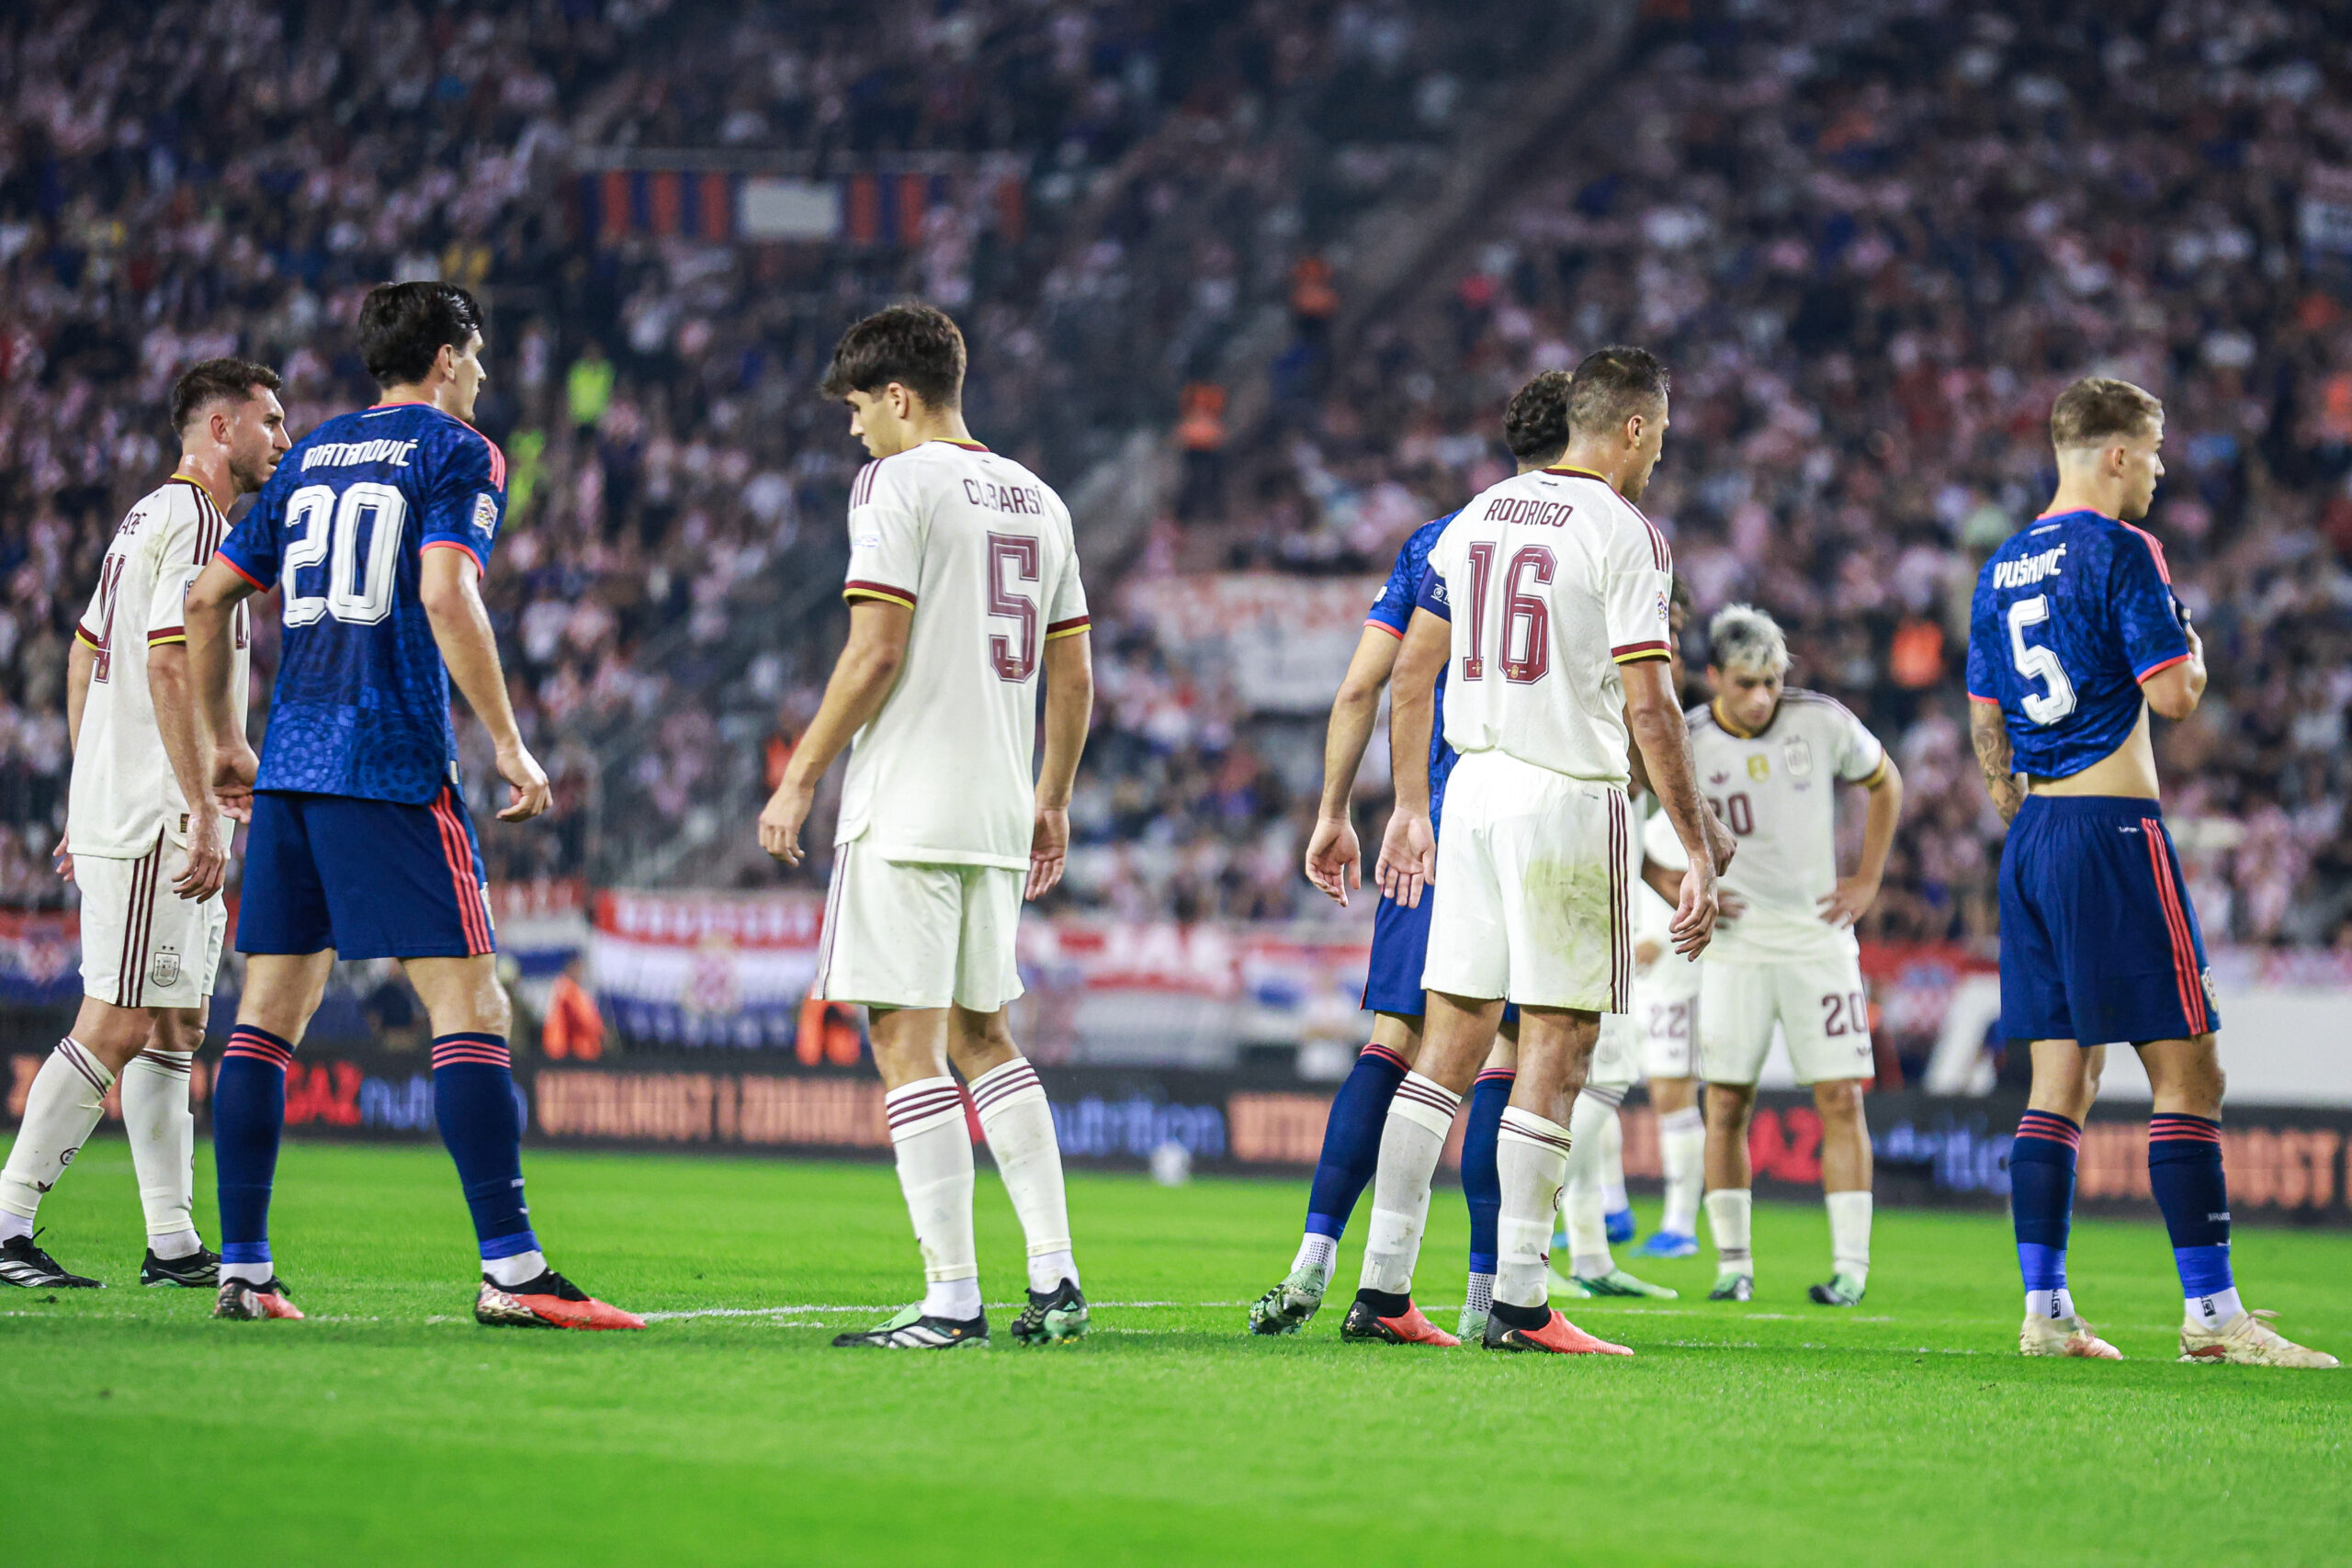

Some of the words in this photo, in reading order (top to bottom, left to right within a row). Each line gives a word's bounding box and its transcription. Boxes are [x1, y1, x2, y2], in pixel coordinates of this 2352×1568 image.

[300, 438, 419, 473] MATANOVIĆ
[281, 481, 408, 628] 20
[1484, 498, 1574, 527] RODRIGO
[987, 530, 1040, 683] 5
[1463, 541, 1558, 685] 16
[2007, 593, 2077, 727] 5
[1650, 1003, 1688, 1039] 22
[1821, 993, 1868, 1038] 20
